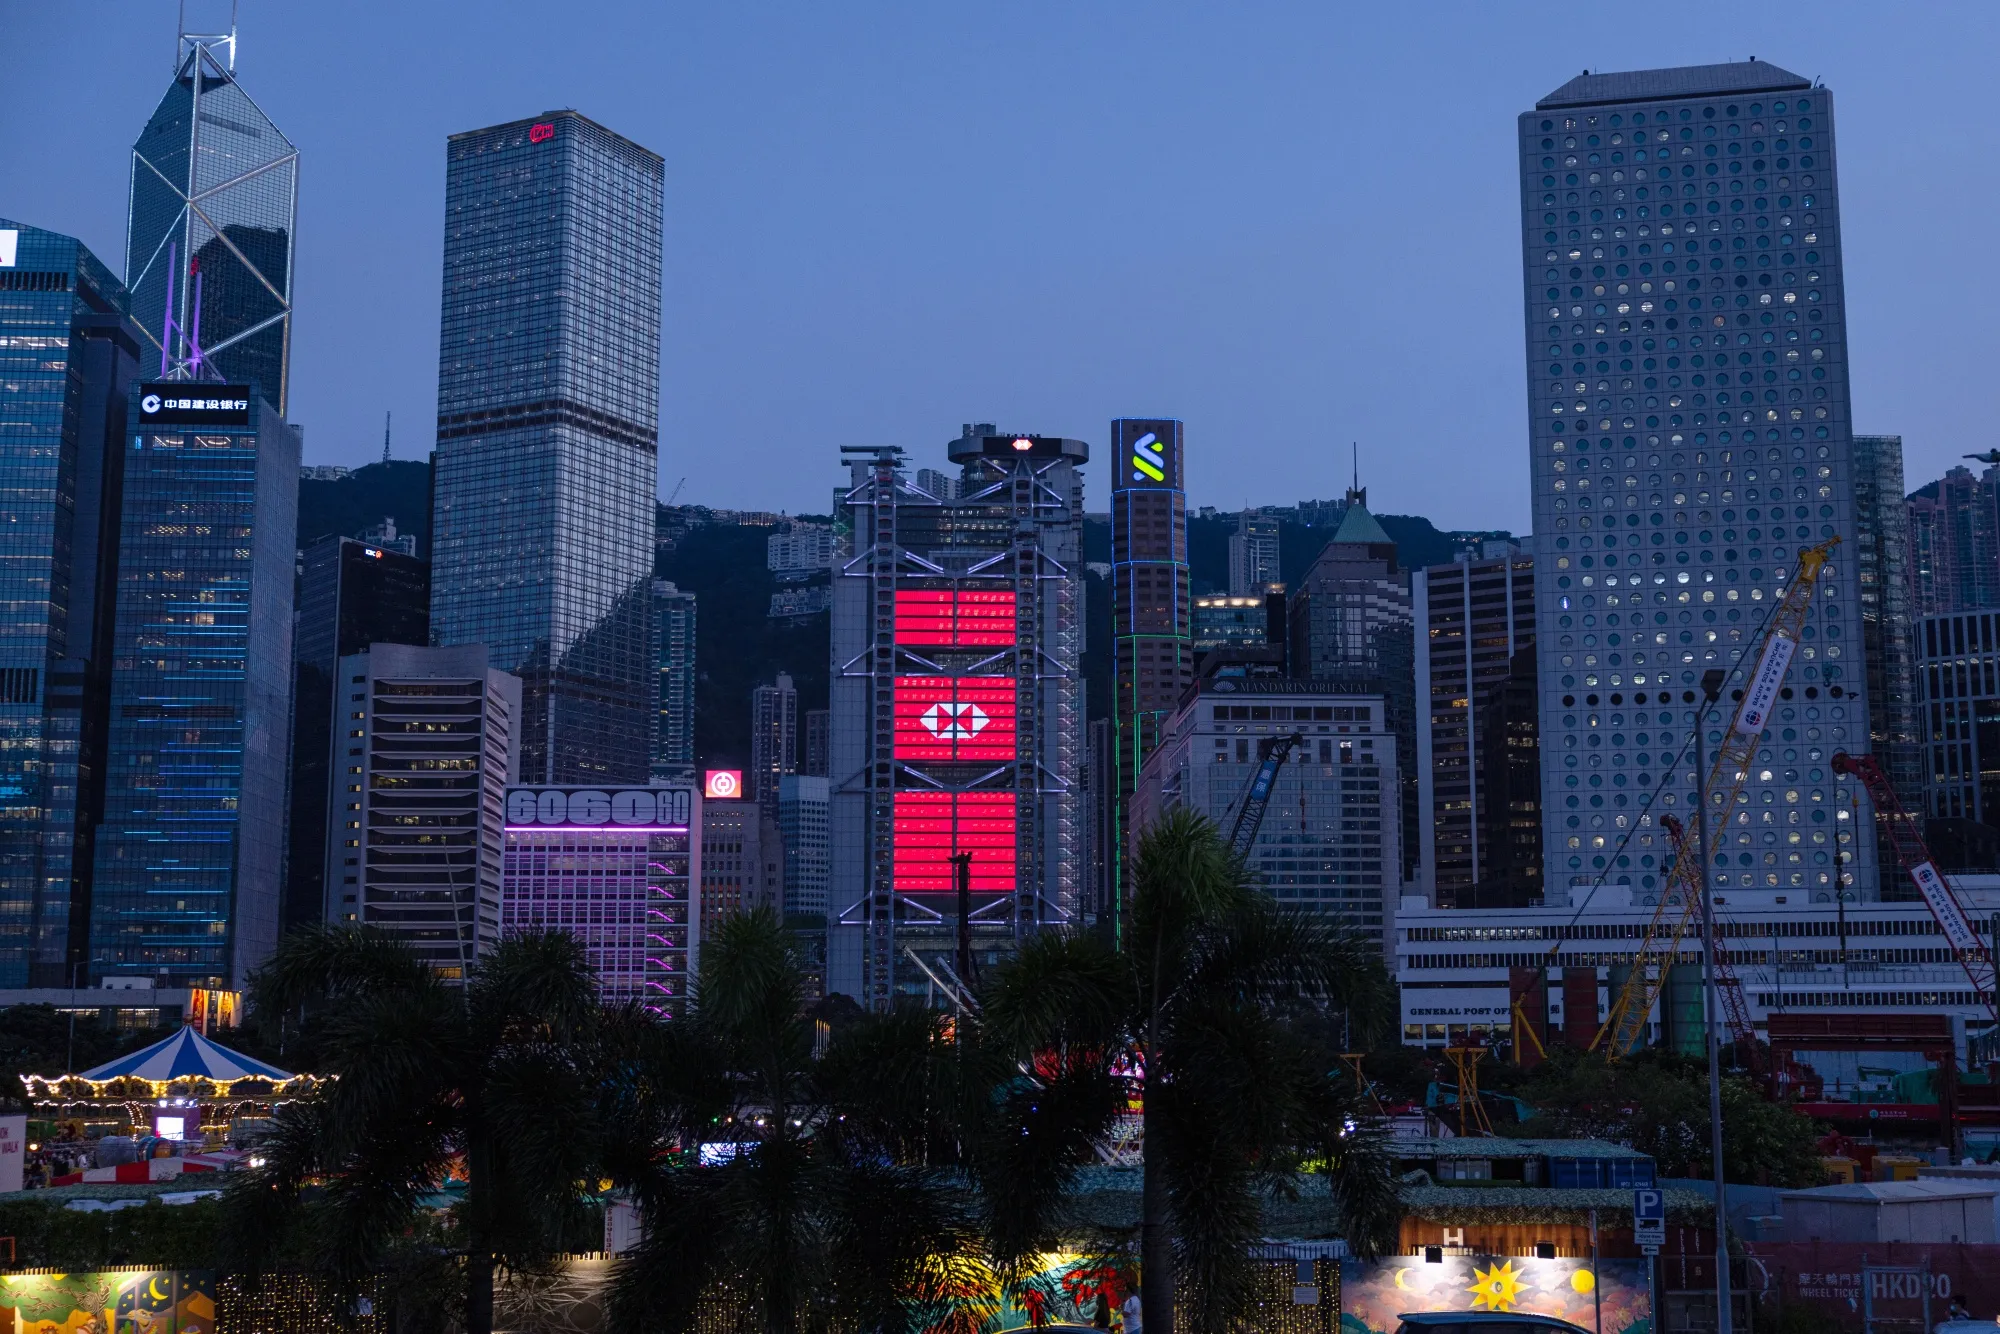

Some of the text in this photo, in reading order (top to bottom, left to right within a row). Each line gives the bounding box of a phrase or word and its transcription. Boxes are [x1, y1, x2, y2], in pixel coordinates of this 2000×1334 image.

[164, 398, 248, 410] 中国建设银行
[1240, 681, 1368, 693] MANDARIN ORIENTAL
[1410, 1007, 1462, 1016] GENERAL
[1464, 1007, 1492, 1016] POST
[1640, 1191, 1659, 1216] P
[1800, 1287, 1862, 1298] WHEEL TICKE
